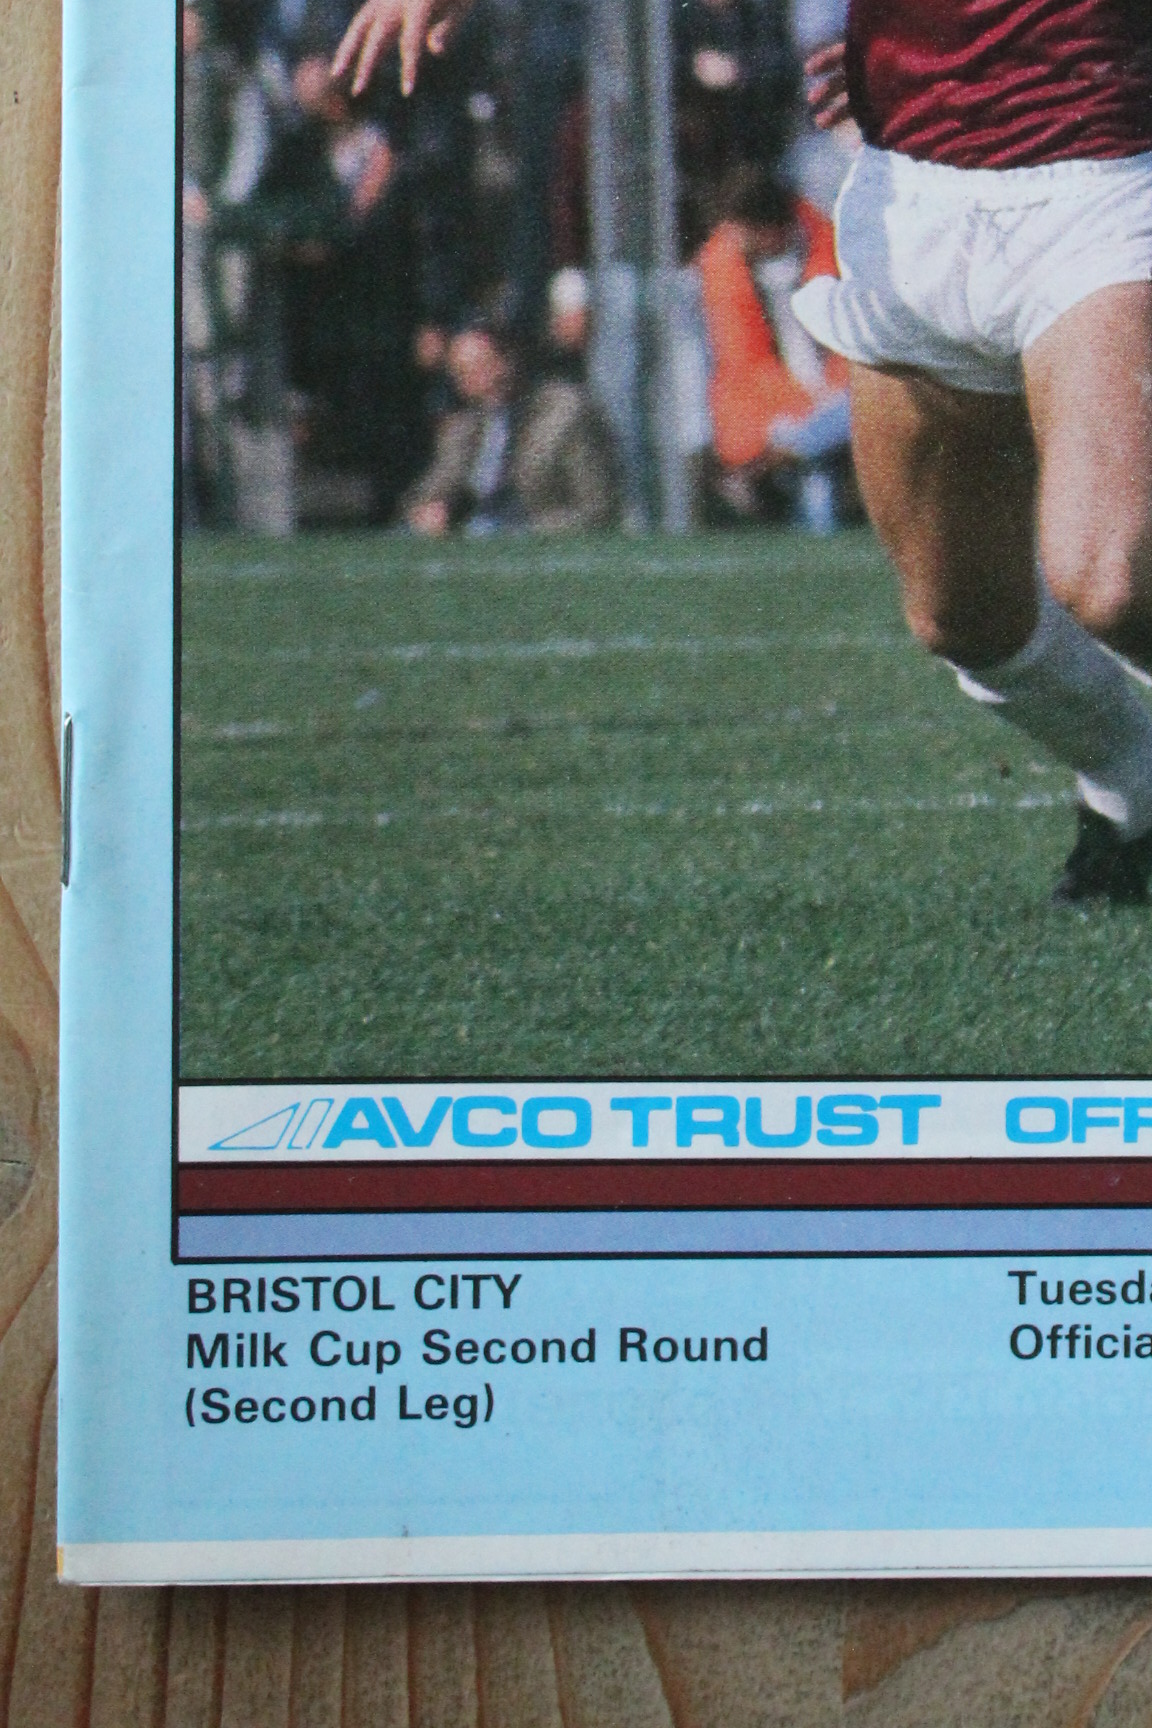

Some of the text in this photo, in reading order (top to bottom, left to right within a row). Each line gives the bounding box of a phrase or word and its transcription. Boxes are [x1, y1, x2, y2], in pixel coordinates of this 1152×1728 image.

[322, 1094, 593, 1150] AVCO
[609, 1094, 943, 1149] TRUST
[187, 1273, 523, 1315] BRISTOL CITY
[186, 1326, 768, 1375] Milk Cup Second Round
[185, 1382, 494, 1429] (Second Leg)
